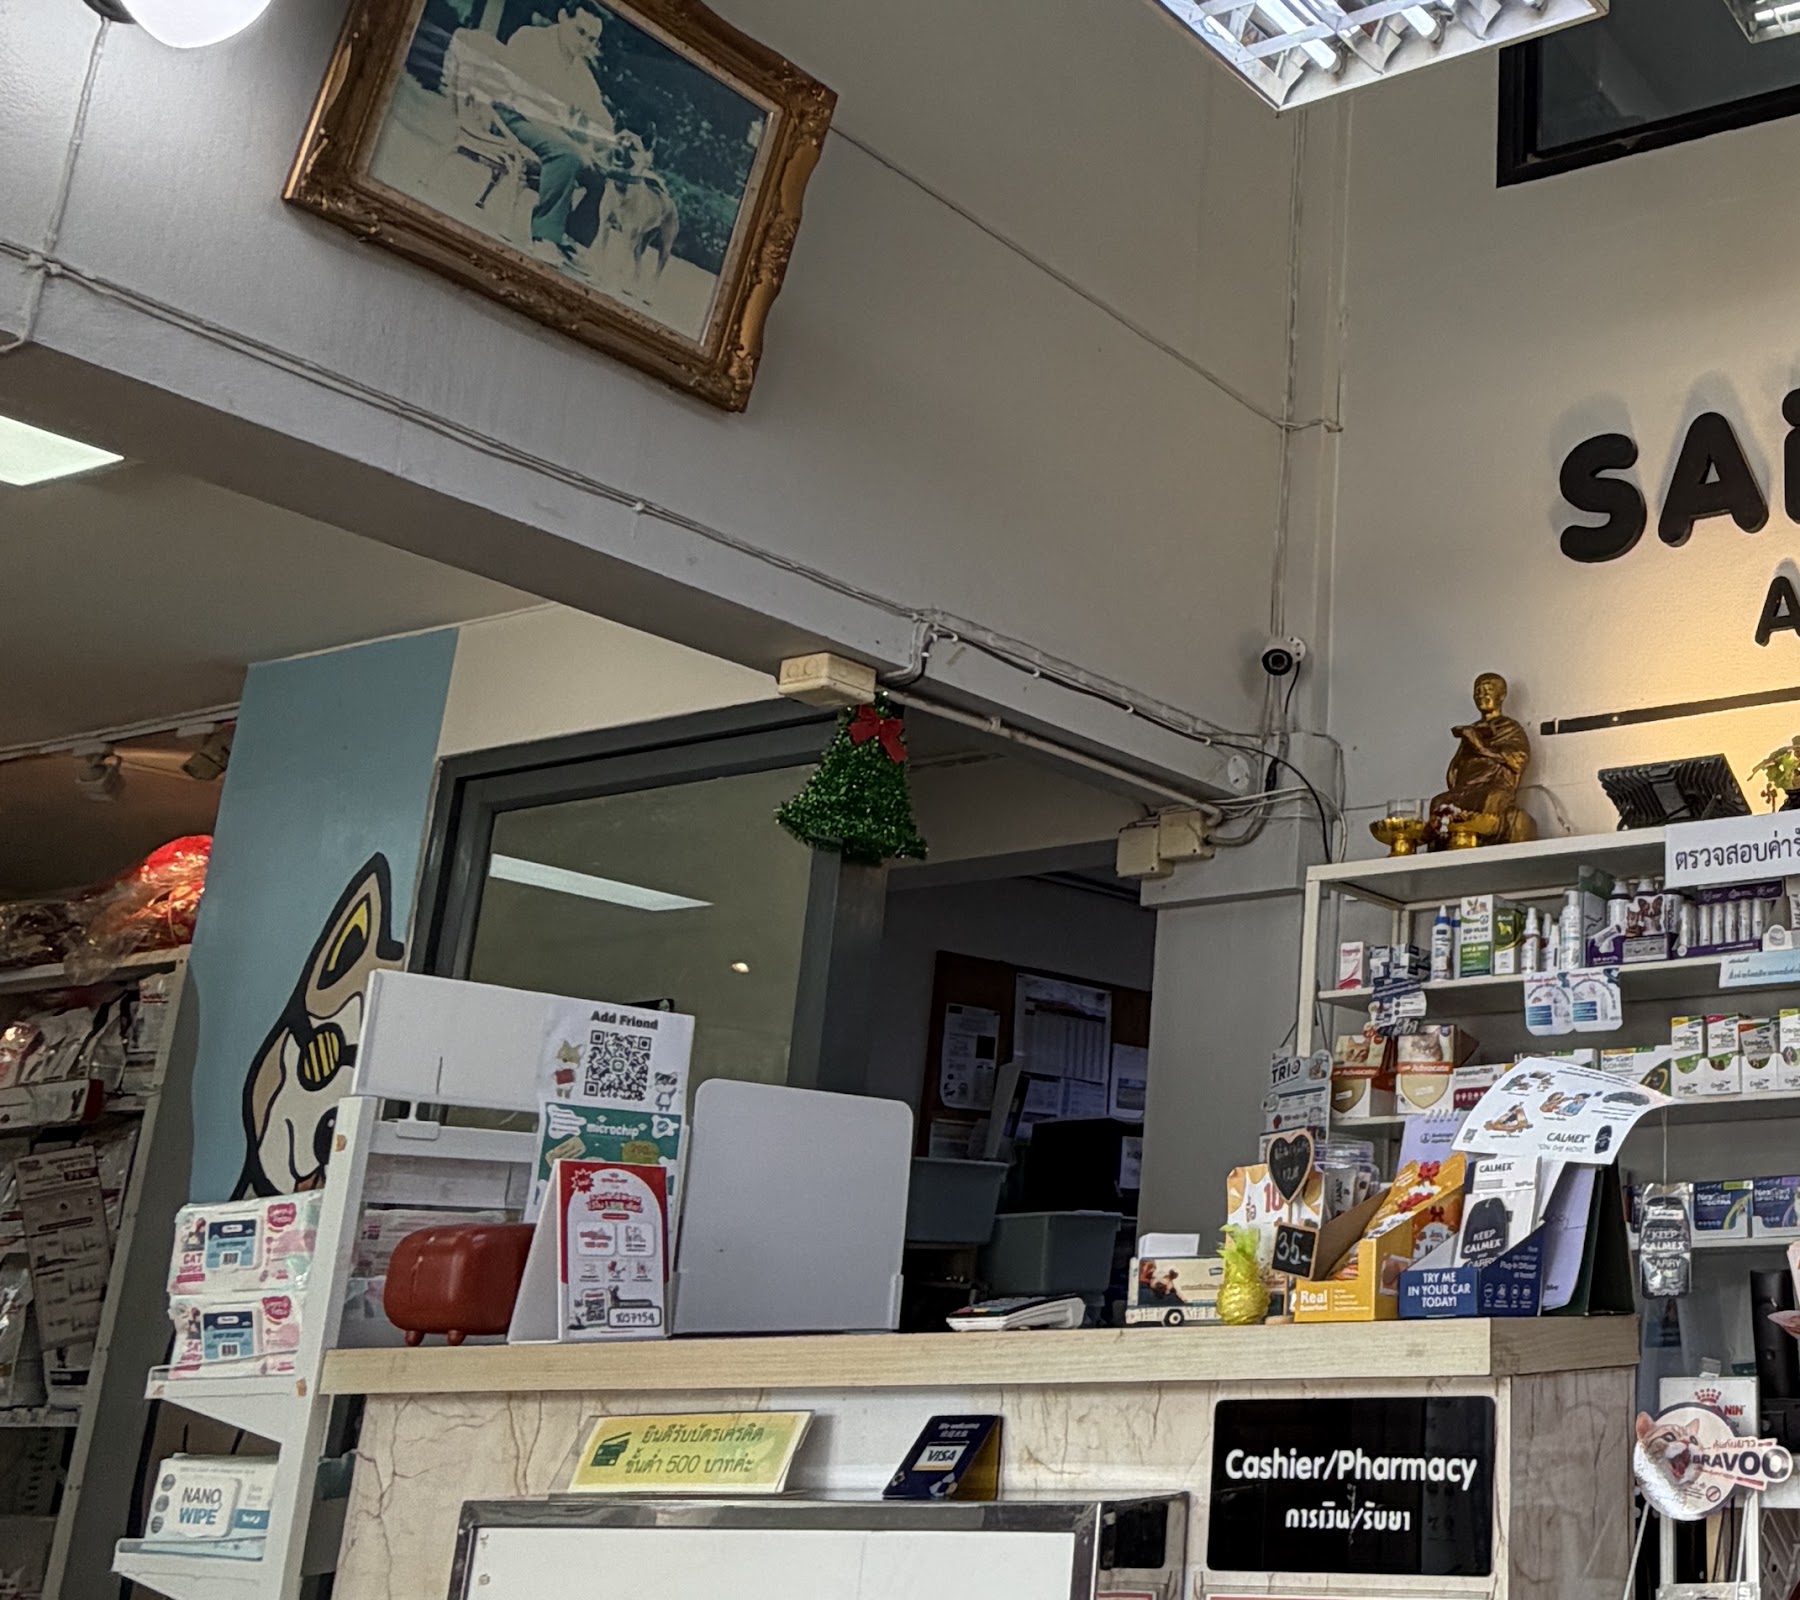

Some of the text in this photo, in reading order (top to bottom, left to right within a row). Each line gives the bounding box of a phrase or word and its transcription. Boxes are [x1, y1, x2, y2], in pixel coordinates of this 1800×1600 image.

[591, 1011, 659, 1030] Add Friend
[1271, 1059, 1301, 1083] TRIO
[586, 1123, 639, 1139] microchip
[1547, 1132, 1588, 1143] CALMEX
[1479, 1162, 1513, 1173] CALMEX
[1473, 1229, 1496, 1240] KEEP
[1650, 1229, 1678, 1240] KEEP
[1464, 1239, 1502, 1253] CALMEX
[182, 1253, 203, 1265] CAT
[1422, 1271, 1457, 1283] TRY ME
[1300, 1289, 1328, 1304] Real
[1408, 1283, 1471, 1297] IN YOUR CAR
[1421, 1296, 1458, 1308] TODAY!
[642, 1422, 765, 1444] ยินดีรับบัตรเครดิต
[625, 1448, 754, 1474] ขั้นต่ำ 500 บาทค่ะ
[925, 1449, 956, 1463] VISA
[1225, 1447, 1477, 1491] Cashier/Pharmacy
[181, 1487, 221, 1504] NANO
[179, 1508, 217, 1526] WIPE
[1284, 1501, 1411, 1532] การเงิน/รับยา
